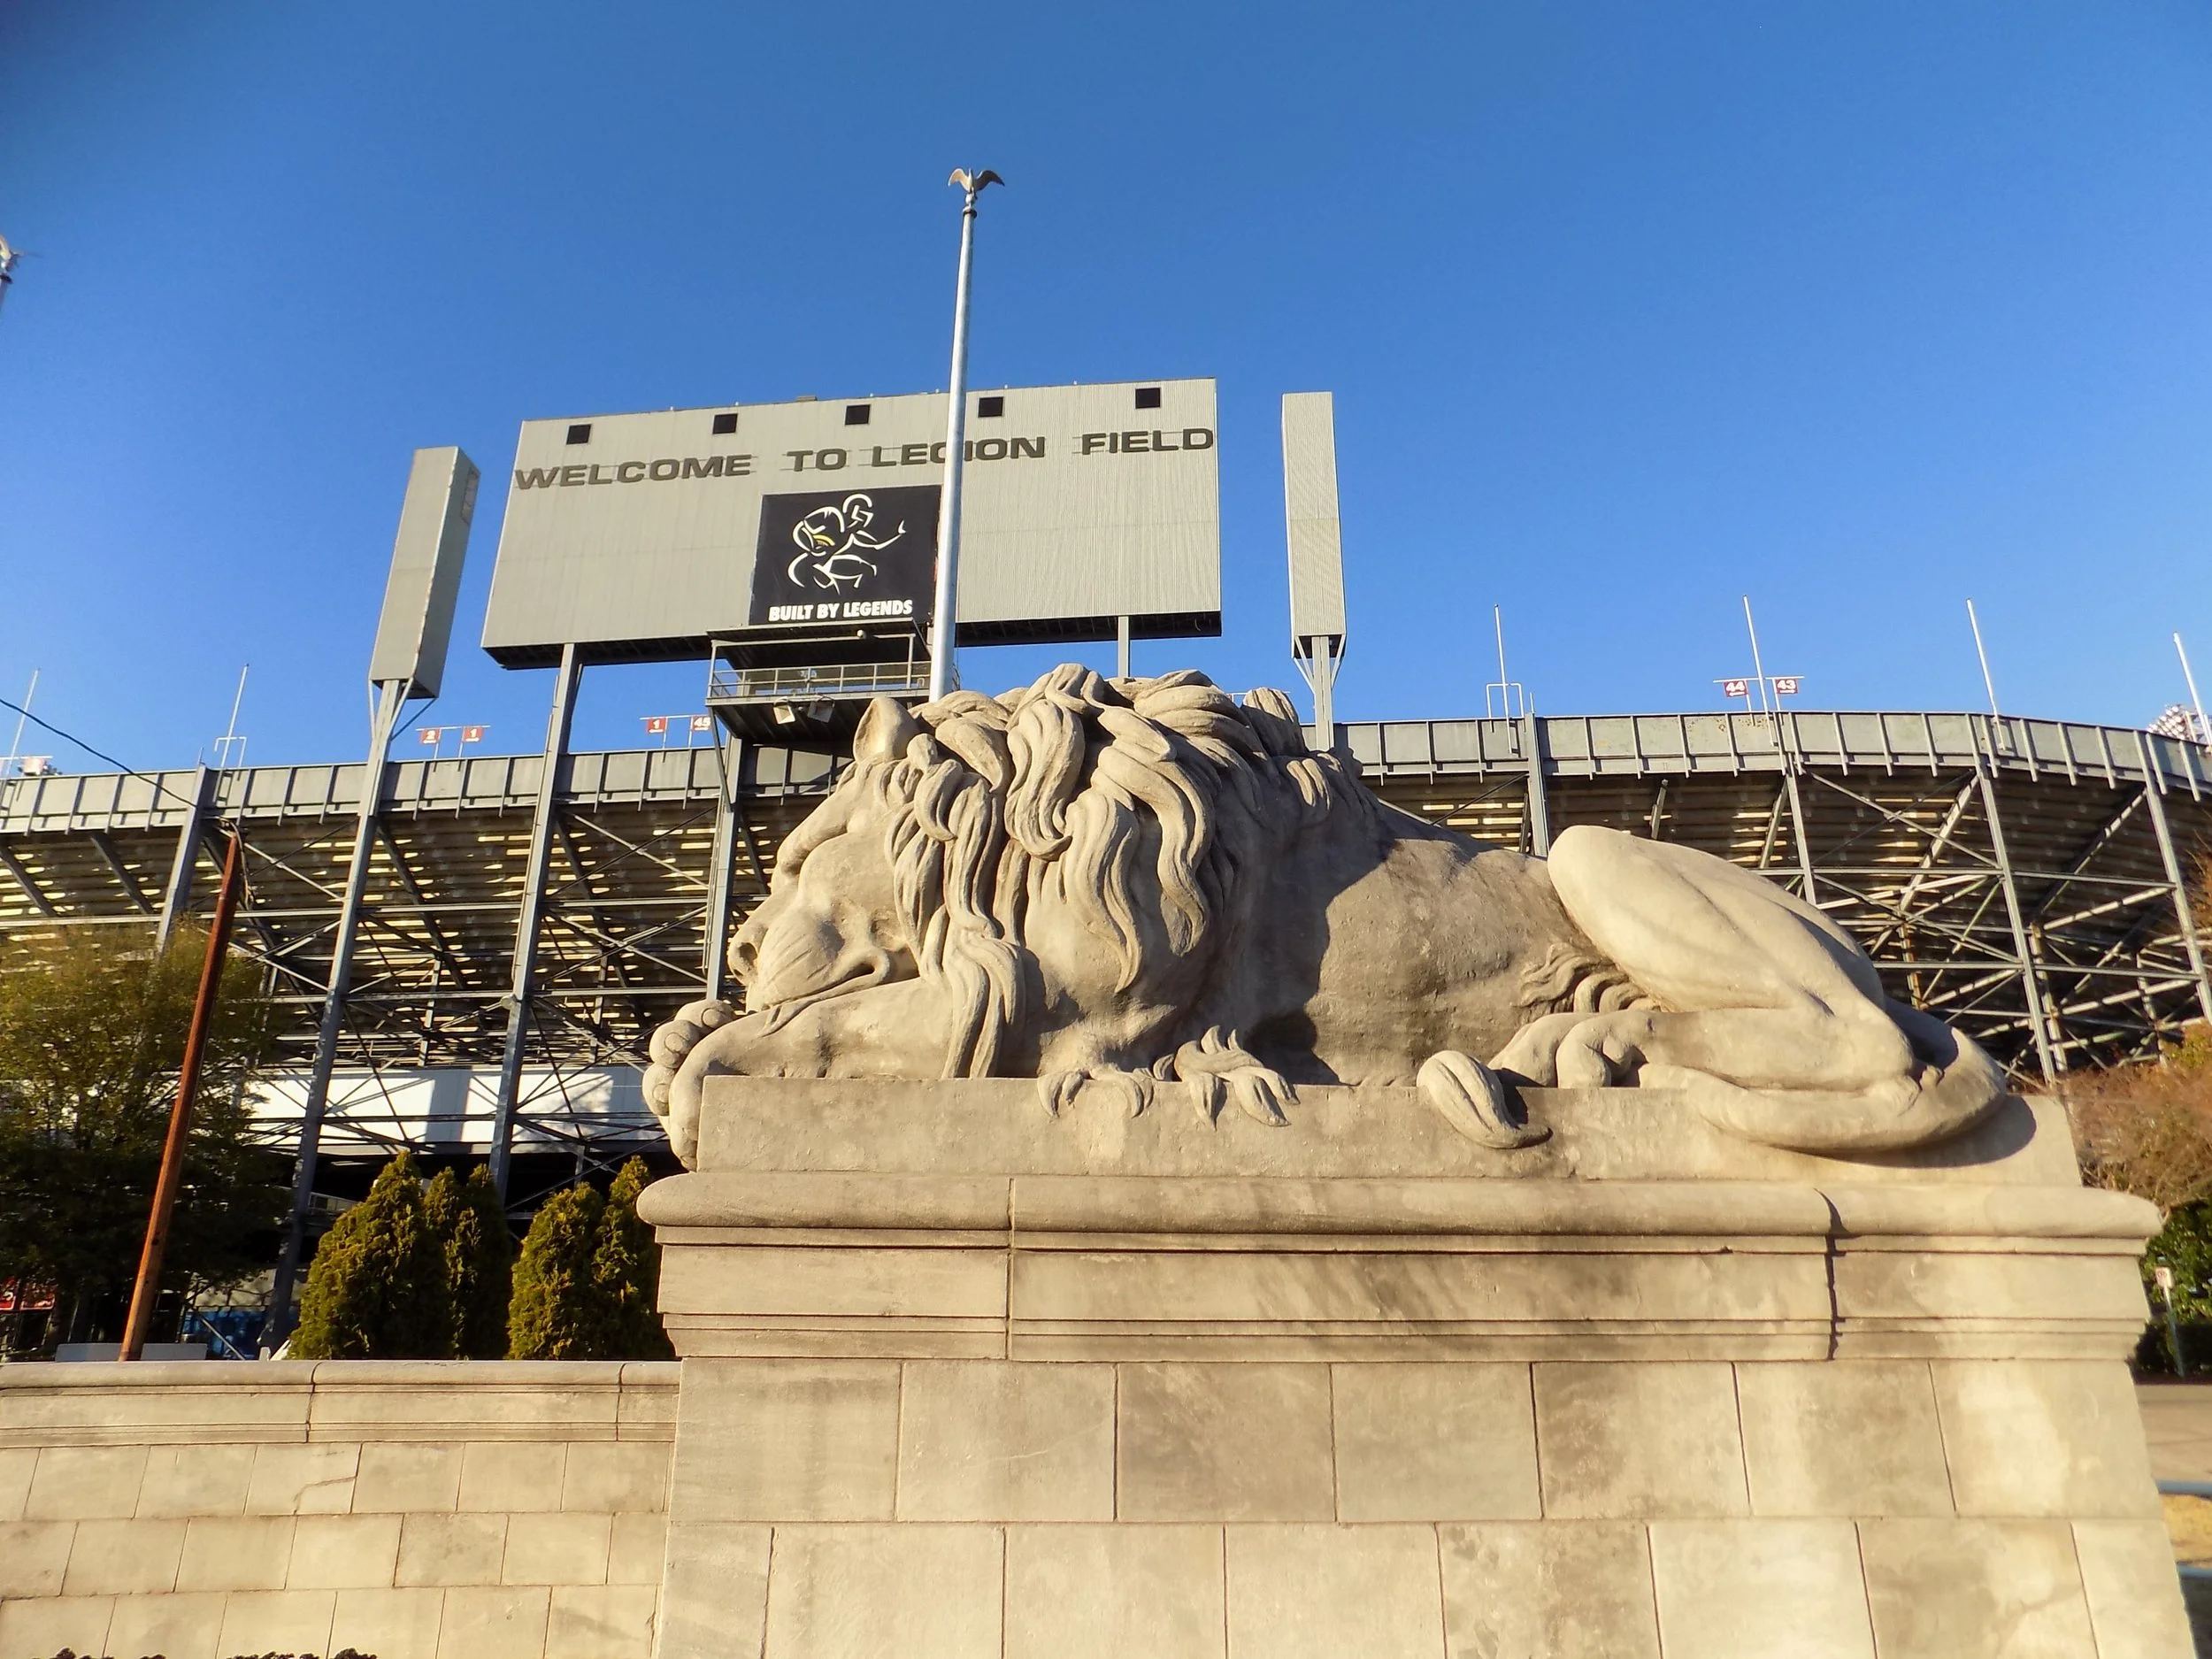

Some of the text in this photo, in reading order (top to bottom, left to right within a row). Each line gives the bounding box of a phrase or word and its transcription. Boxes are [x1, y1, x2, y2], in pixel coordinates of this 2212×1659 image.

[516, 455, 751, 489] WELCOME
[787, 448, 848, 472] TO
[1081, 427, 1214, 456] FIELD
[769, 600, 913, 621] BUILT BY LEGENDS
[1726, 681, 1745, 692] 44
[1777, 680, 1796, 690] 43
[653, 718, 660, 730] 1
[694, 717, 711, 727] 45
[426, 730, 435, 740] 2
[470, 728, 477, 738] 1
